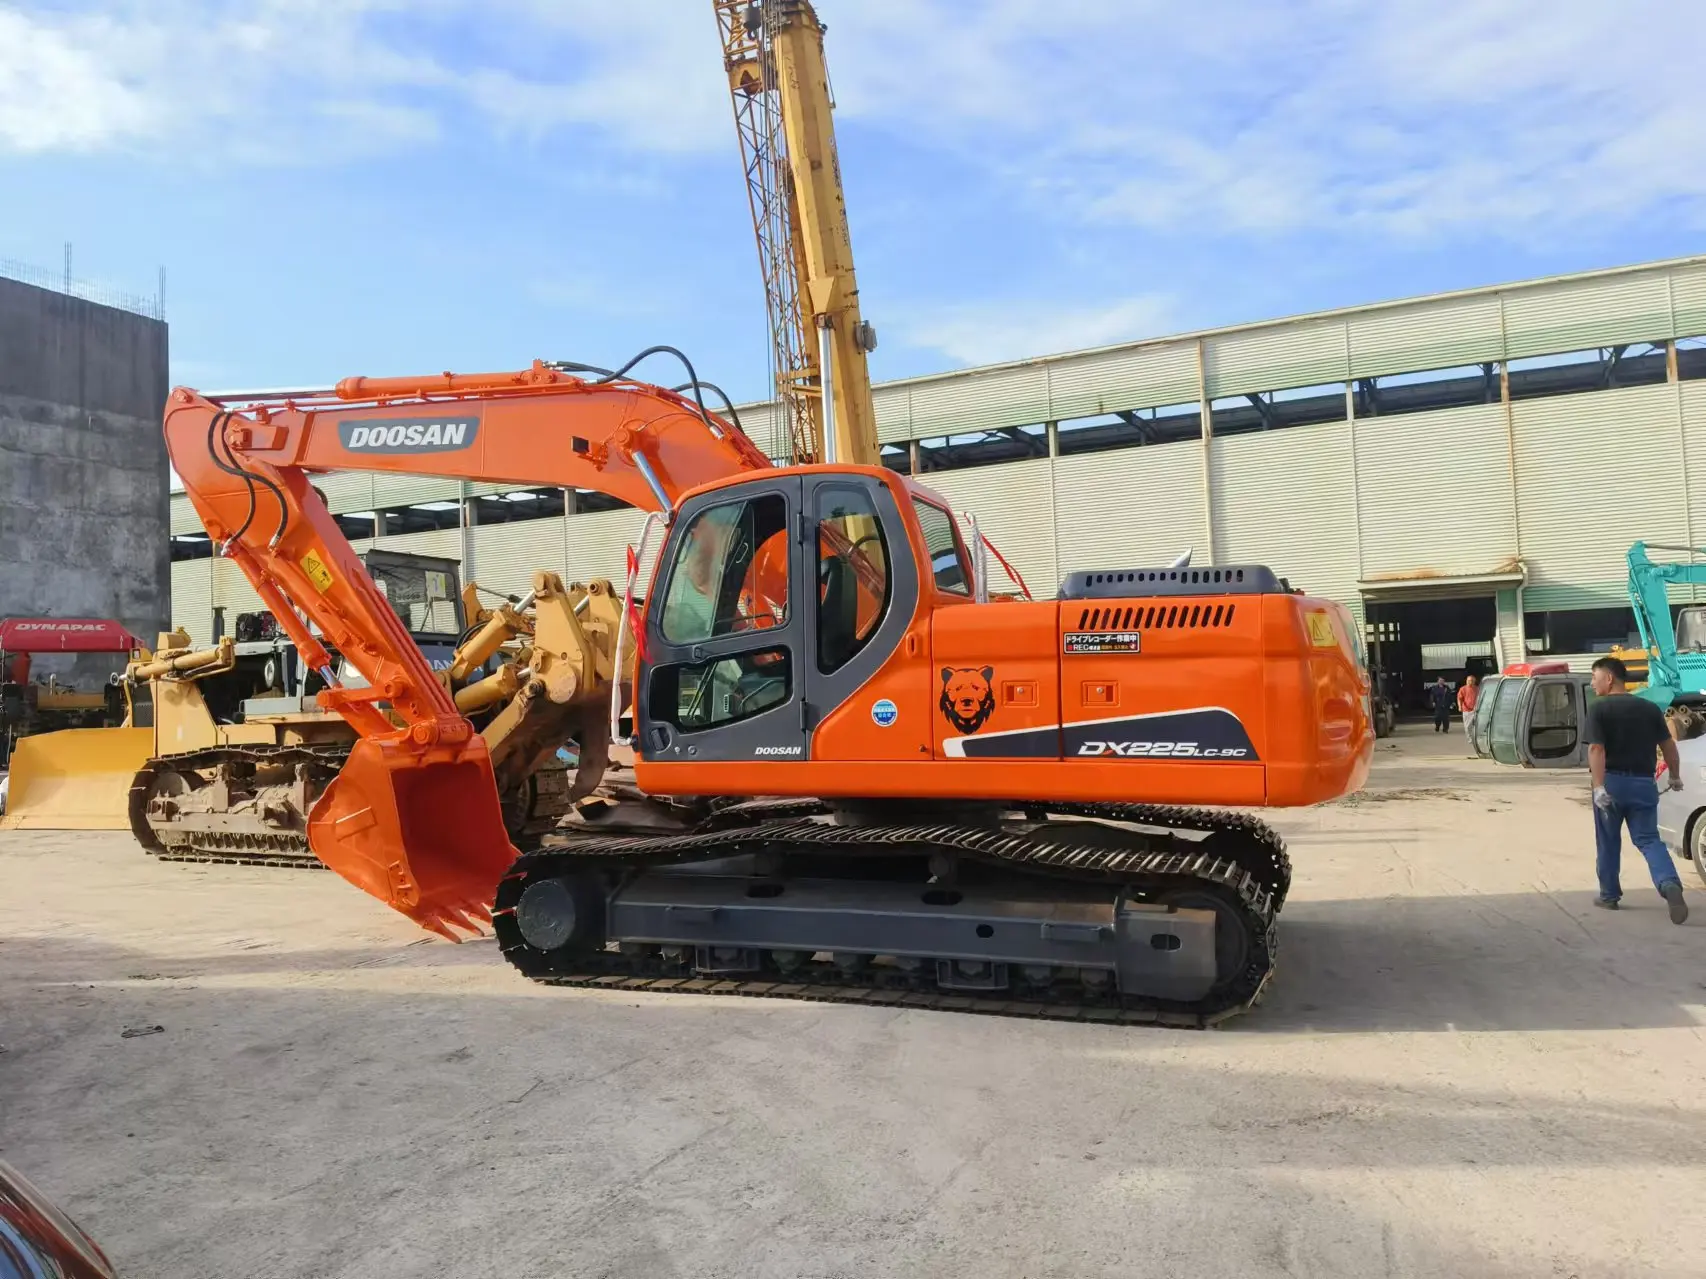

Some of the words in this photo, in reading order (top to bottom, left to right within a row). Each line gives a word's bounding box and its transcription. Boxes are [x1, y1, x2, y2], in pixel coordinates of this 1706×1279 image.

[348, 423, 467, 448] DOOSAN
[15, 623, 106, 631] DYNAPAC
[755, 746, 801, 755] DOOSAN
